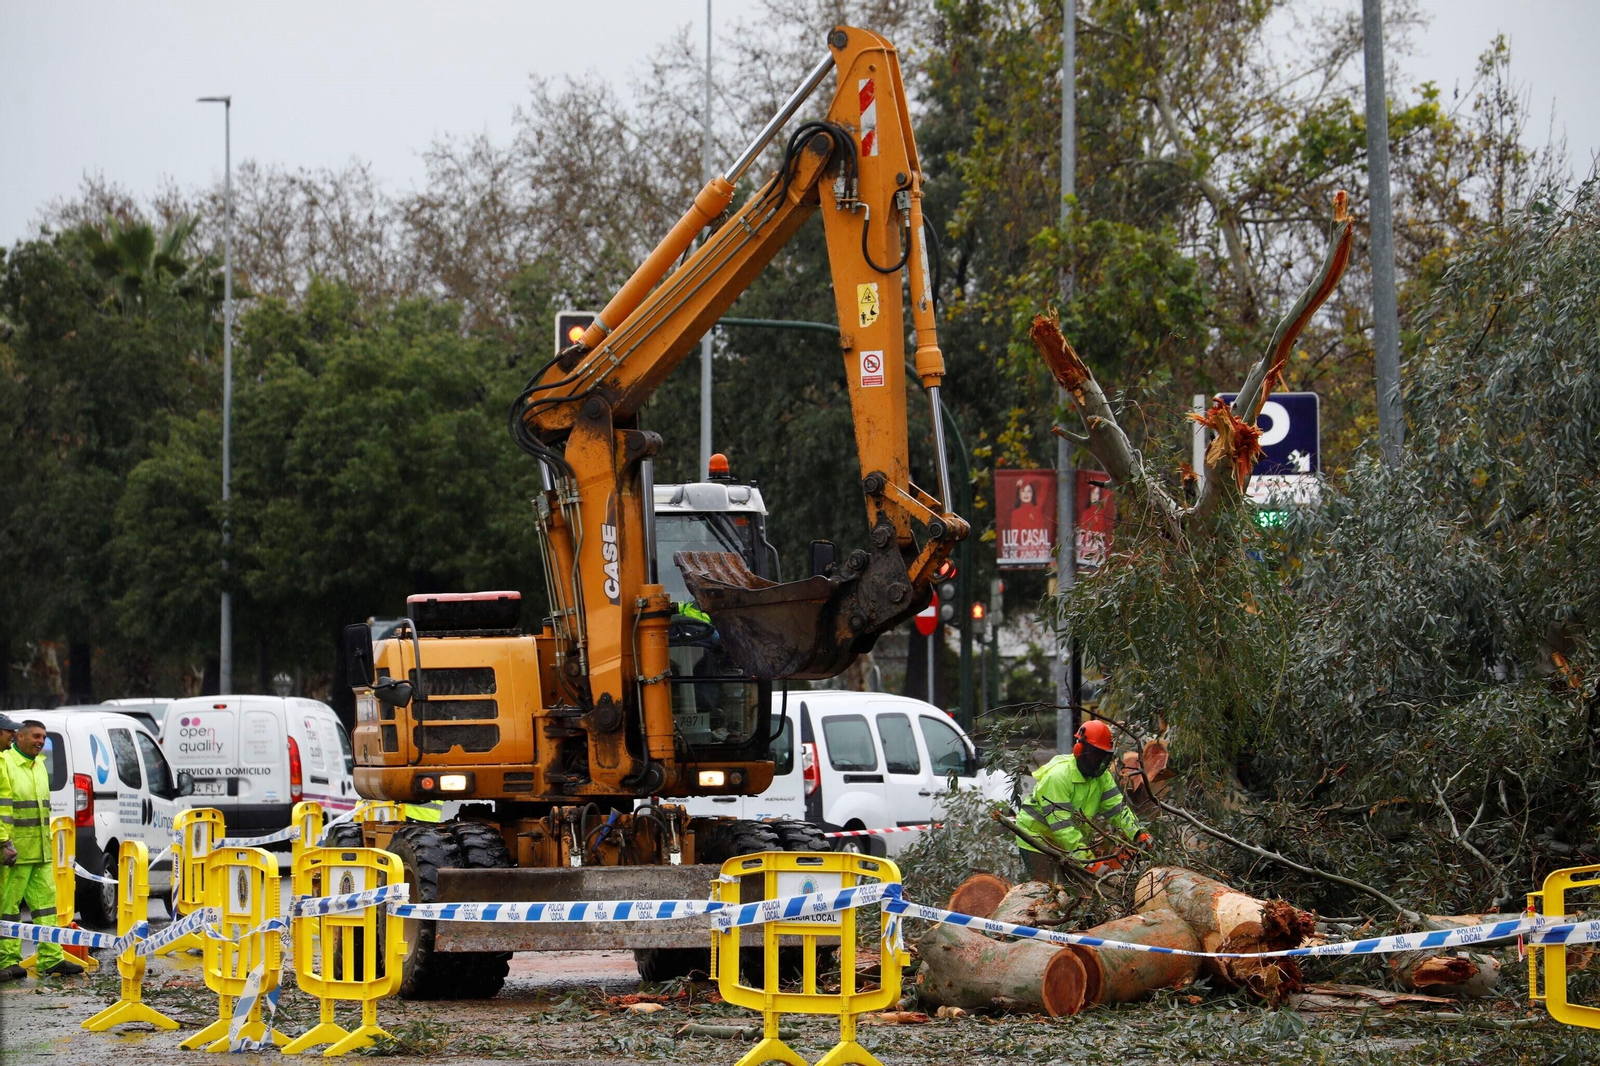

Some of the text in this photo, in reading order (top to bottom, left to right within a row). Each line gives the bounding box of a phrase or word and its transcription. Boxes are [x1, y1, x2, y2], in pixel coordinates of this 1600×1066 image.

[1002, 529, 1051, 546] LUZ CASAL
[602, 523, 620, 599] CASE
[179, 727, 216, 739] open
[178, 740, 224, 753] quality
[176, 767, 271, 776] SERVICIO A DOMICILIO
[205, 784, 222, 793] FLY
[394, 884, 400, 893] NO
[816, 893, 823, 902] NO
[510, 903, 516, 912] NO
[547, 903, 564, 911] POLICIA
[597, 902, 603, 911] NO
[636, 902, 652, 910] POLICIA
[762, 901, 780, 911] POLICIA
[813, 902, 828, 913] PASAR
[550, 911, 564, 921] LOCAL
[594, 911, 607, 920] PASAR
[638, 910, 652, 919] LOCAL
[764, 911, 780, 921] LOCAL
[811, 914, 837, 923] LOCAL
[919, 908, 939, 920] LOCAL
[718, 917, 731, 927] PASAR
[1536, 917, 1546, 926] NO
[985, 922, 1003, 932] PASAR
[1457, 927, 1483, 935] POLICIA
[1590, 922, 1600, 931] NO
[1396, 936, 1405, 945] NO
[1461, 933, 1482, 943] LOCAL
[1318, 944, 1344, 953] POLICIA
